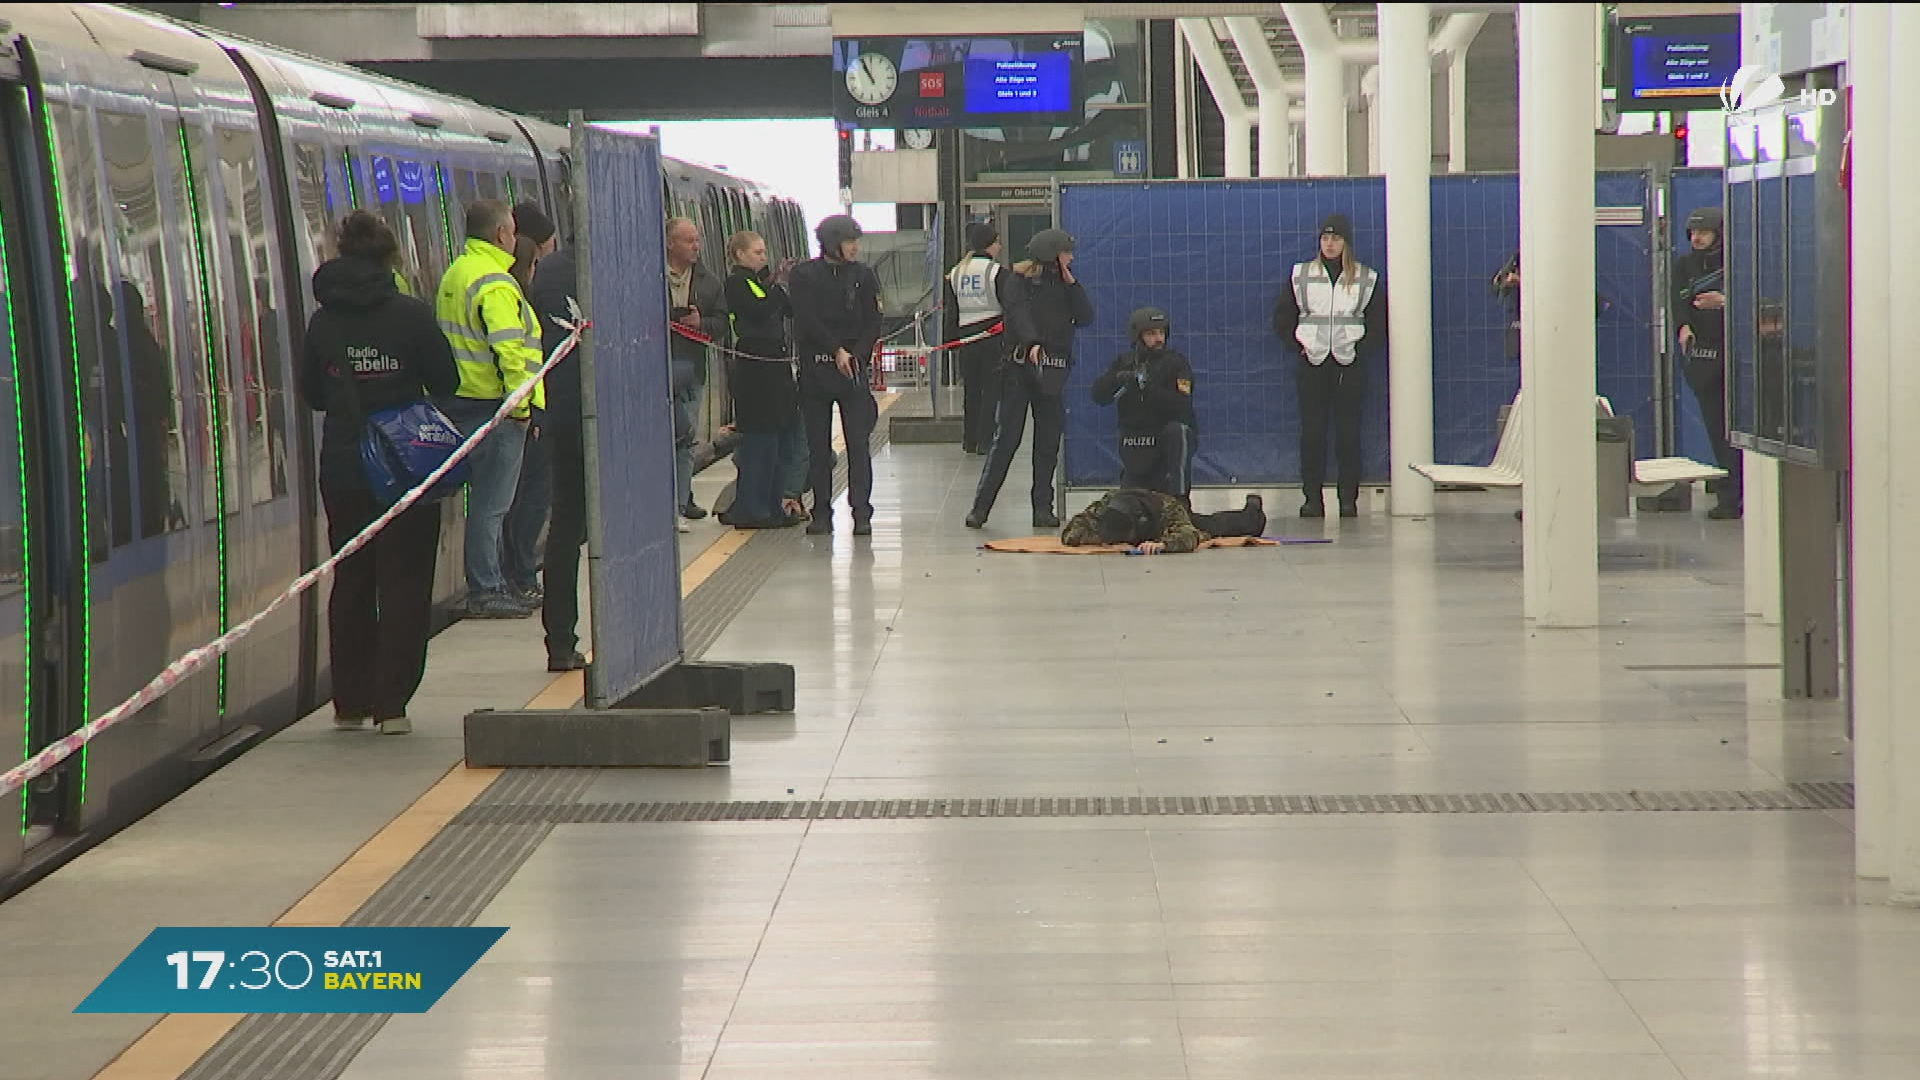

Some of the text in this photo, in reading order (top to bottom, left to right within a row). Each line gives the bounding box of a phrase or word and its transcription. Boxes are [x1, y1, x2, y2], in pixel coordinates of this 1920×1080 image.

[921, 78, 942, 90] SOS
[855, 107, 890, 118] Gleis 4
[961, 275, 981, 290] PE
[346, 346, 379, 358] Radio
[1123, 436, 1156, 447] POLIZEI
